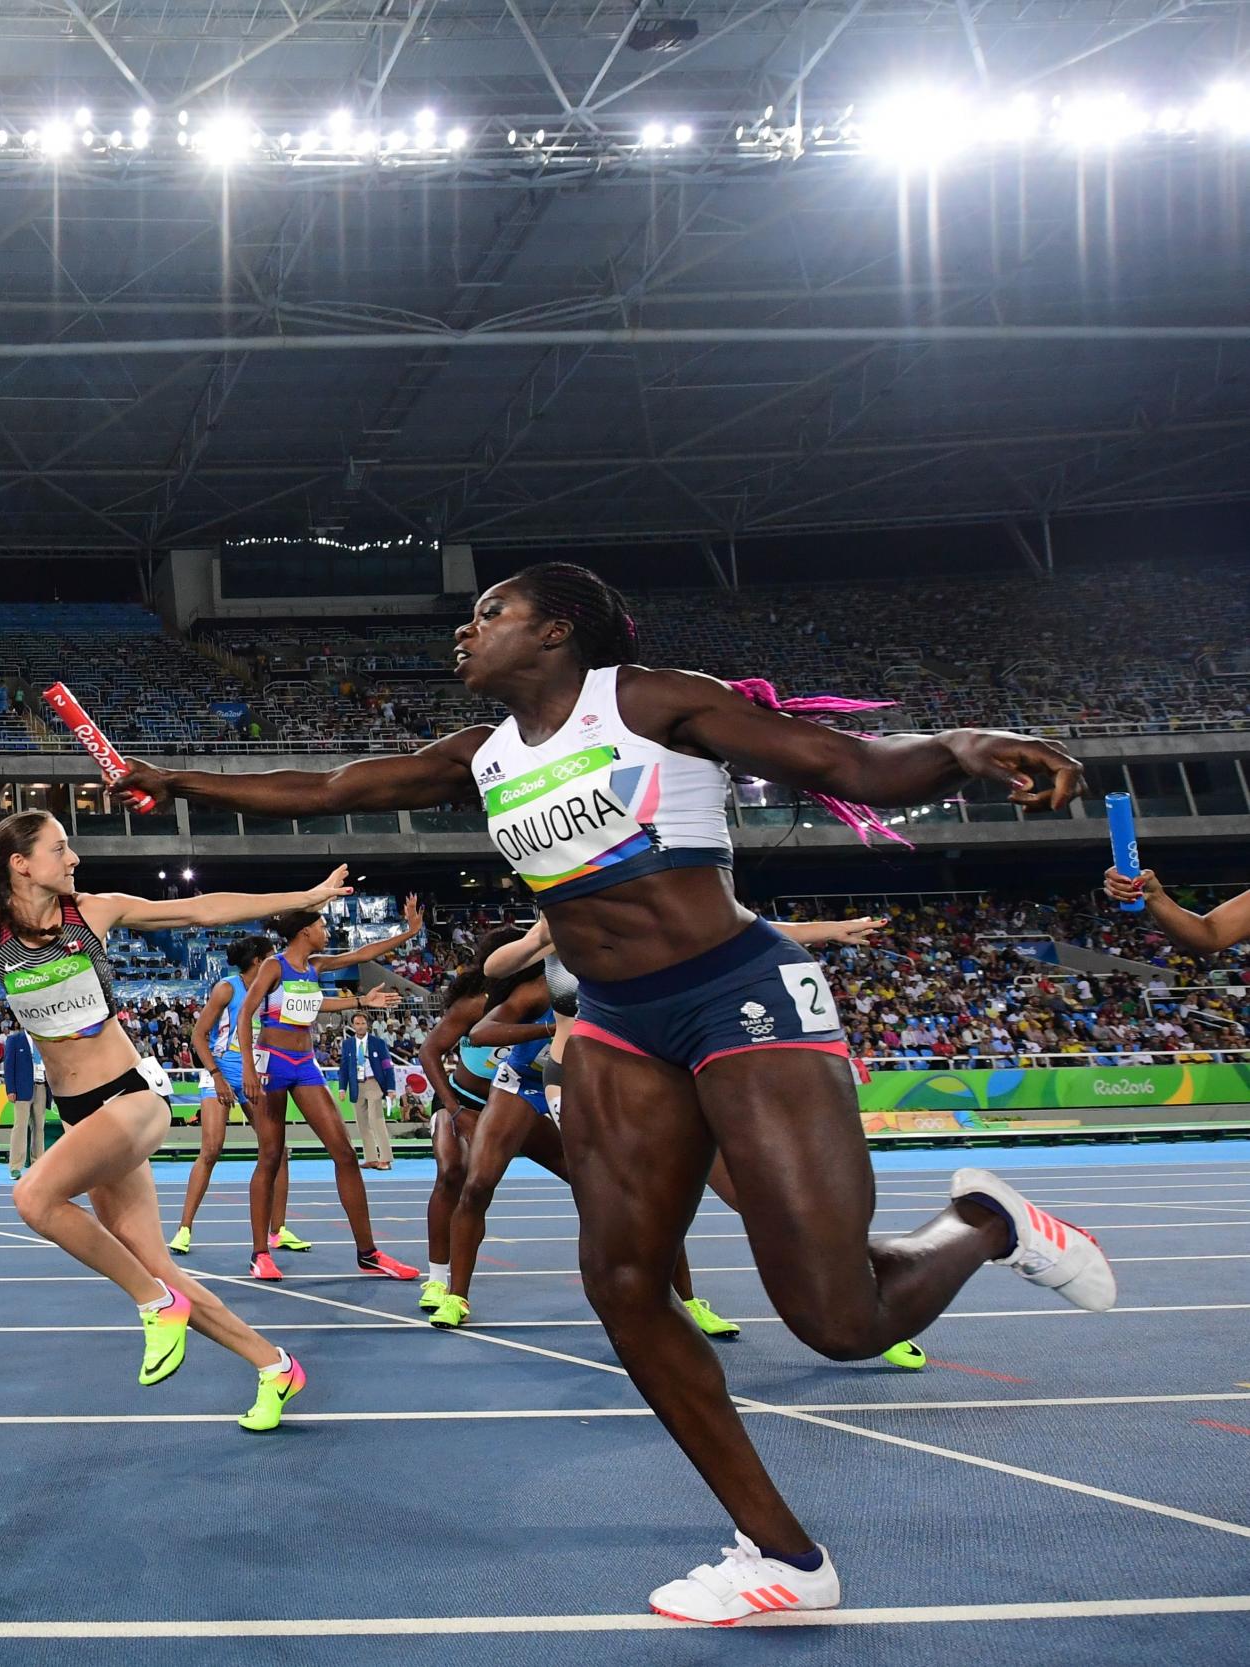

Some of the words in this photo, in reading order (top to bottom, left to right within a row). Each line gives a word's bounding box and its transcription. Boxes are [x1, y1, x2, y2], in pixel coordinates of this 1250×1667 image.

[53, 695, 66, 707] 2
[74, 724, 127, 781] Rio2016
[478, 773, 506, 786] adidas
[500, 775, 546, 804] Rio2016
[496, 788, 626, 861] ONUORA
[14, 972, 50, 988] Rio2016
[799, 976, 826, 1015] 2
[18, 993, 97, 1020] MONTCALM
[286, 998, 321, 1012] GOMEZ
[739, 1018, 762, 1027] TEAM
[1093, 1078, 1156, 1096] Rio2016
